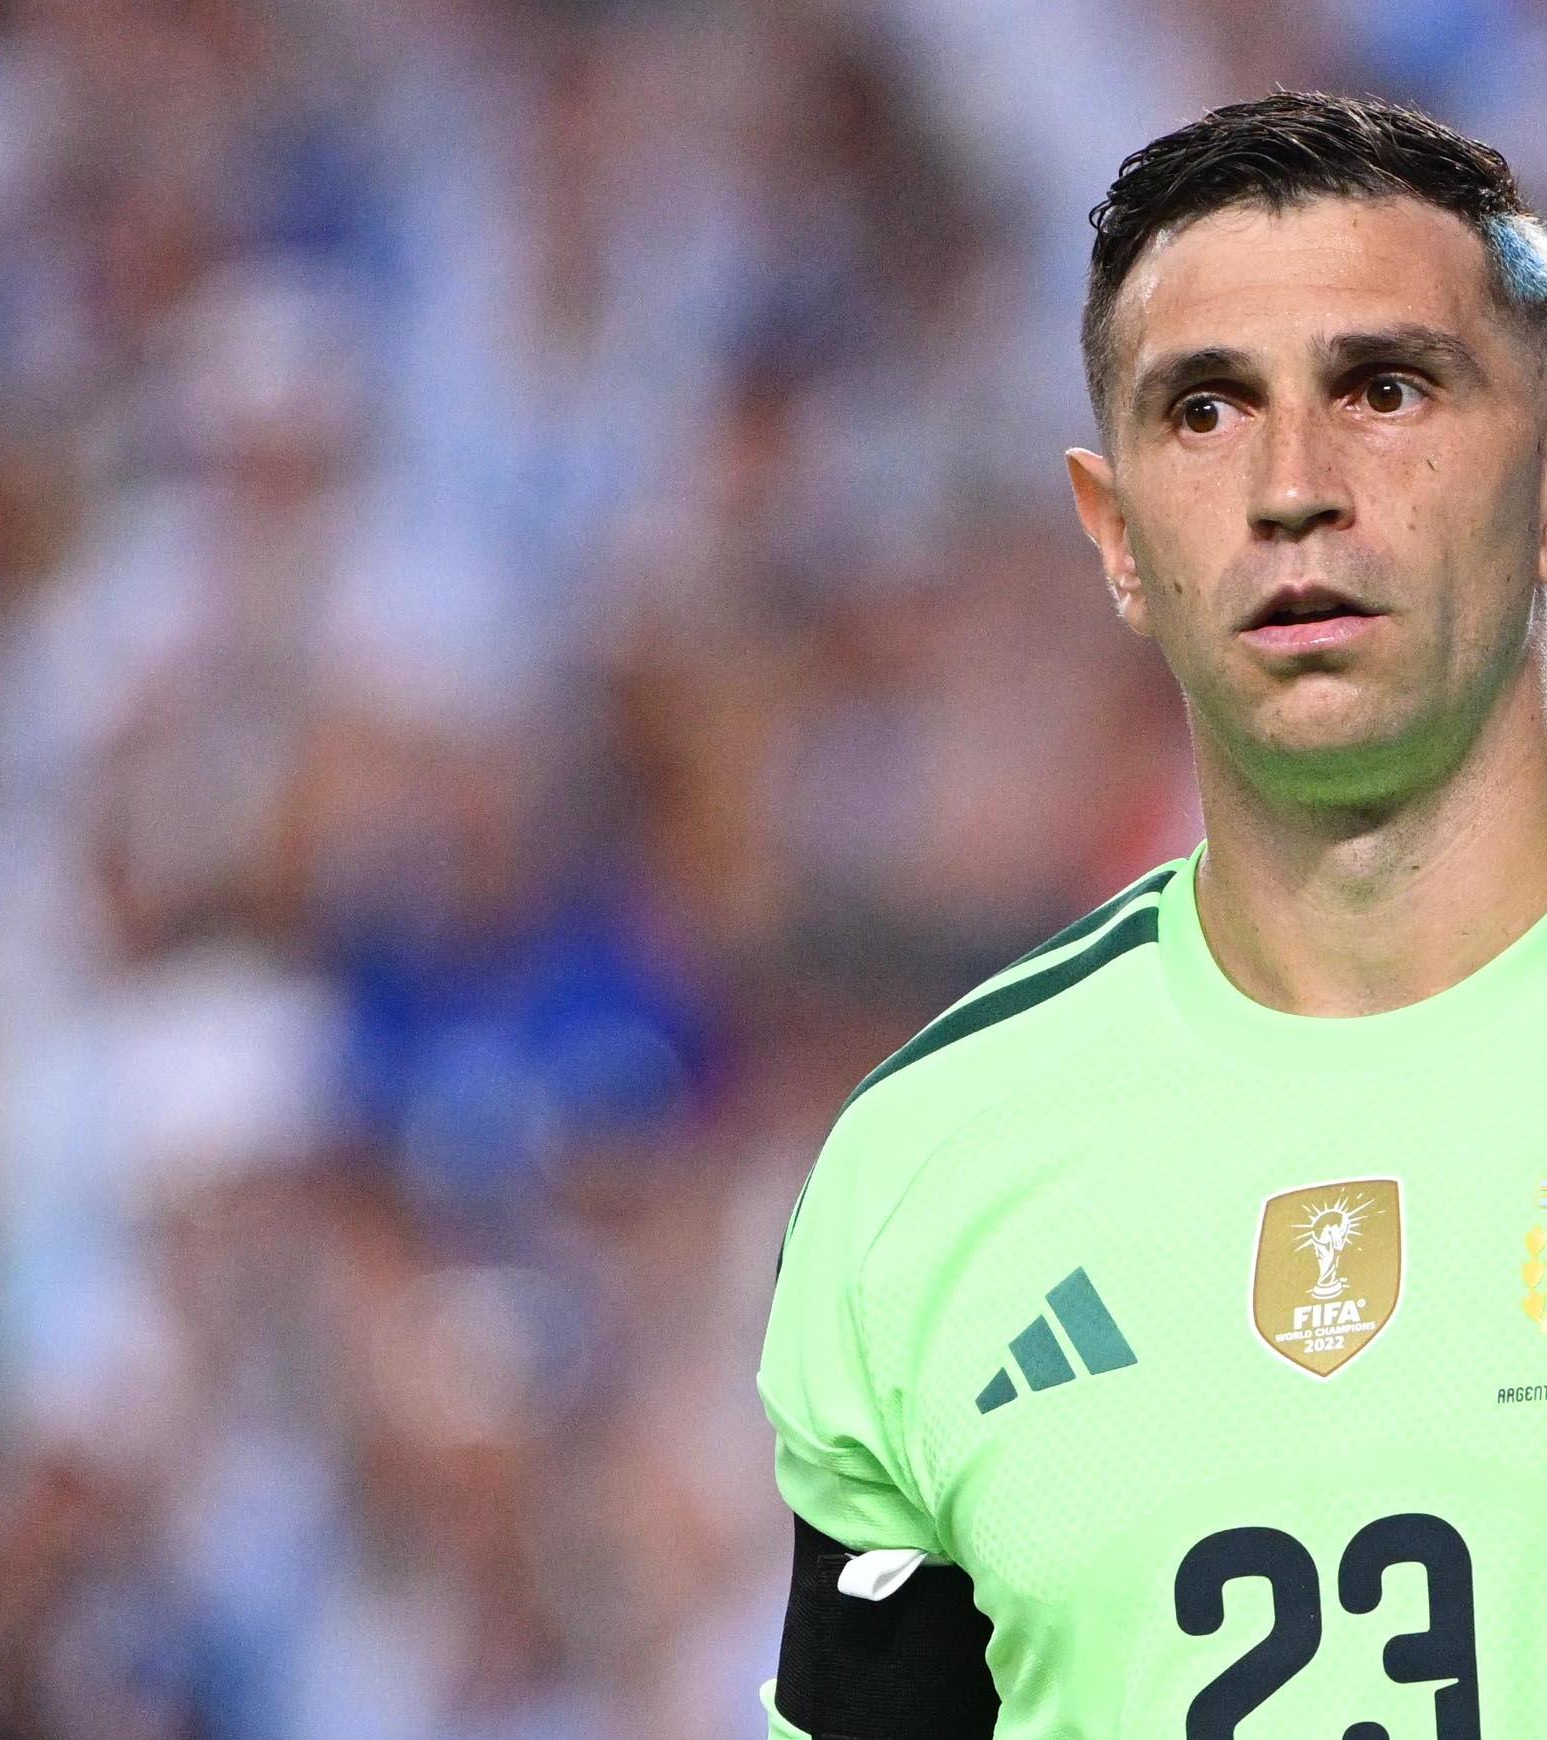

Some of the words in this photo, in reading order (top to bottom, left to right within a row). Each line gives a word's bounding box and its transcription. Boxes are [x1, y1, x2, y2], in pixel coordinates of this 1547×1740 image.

[1275, 1330, 1313, 1343] WORLD
[1314, 1321, 1376, 1337] CHAMPIONS
[1303, 1335, 1345, 1354] 2022
